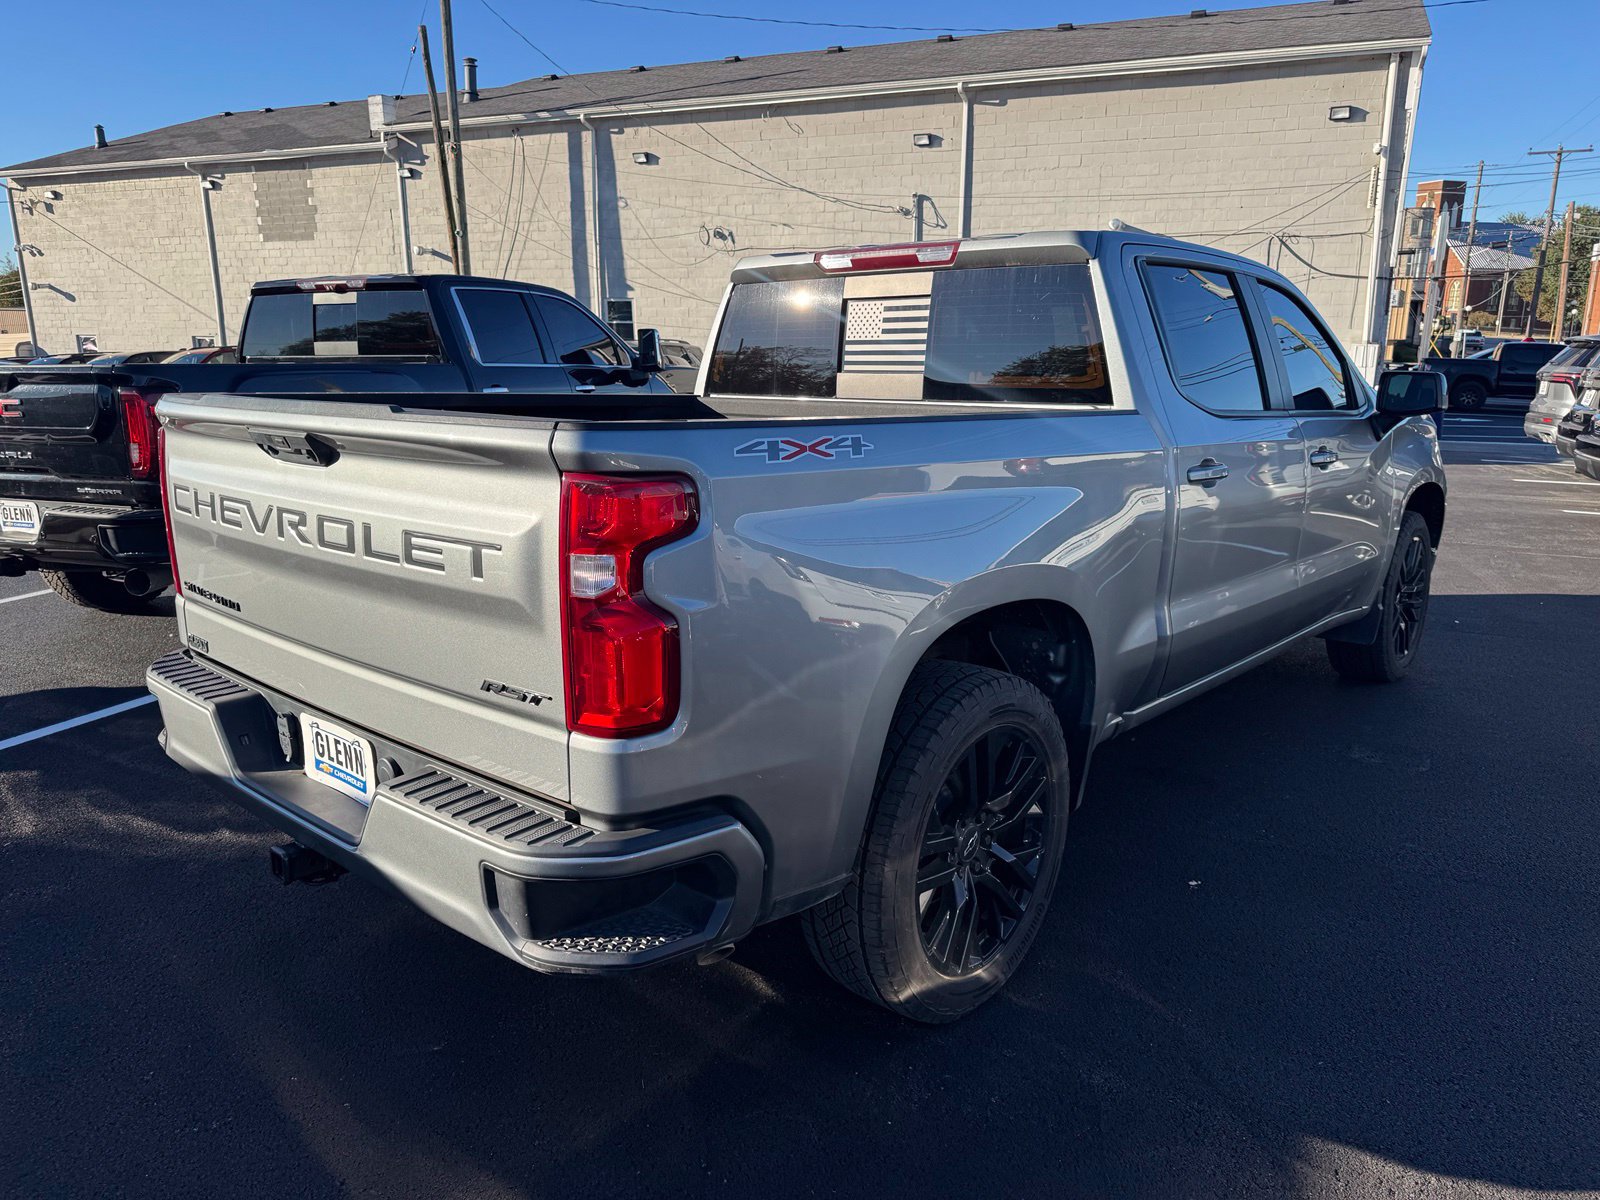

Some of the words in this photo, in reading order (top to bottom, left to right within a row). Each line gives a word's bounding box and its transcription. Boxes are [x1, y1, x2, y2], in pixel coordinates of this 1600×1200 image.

[3, 507, 32, 521] GLENN
[173, 482, 502, 581] CHEVROLET
[184, 581, 241, 611] SILVERADO
[480, 679, 553, 706] RST
[315, 731, 364, 778] GLENN
[334, 769, 364, 789] CHEVROLET
